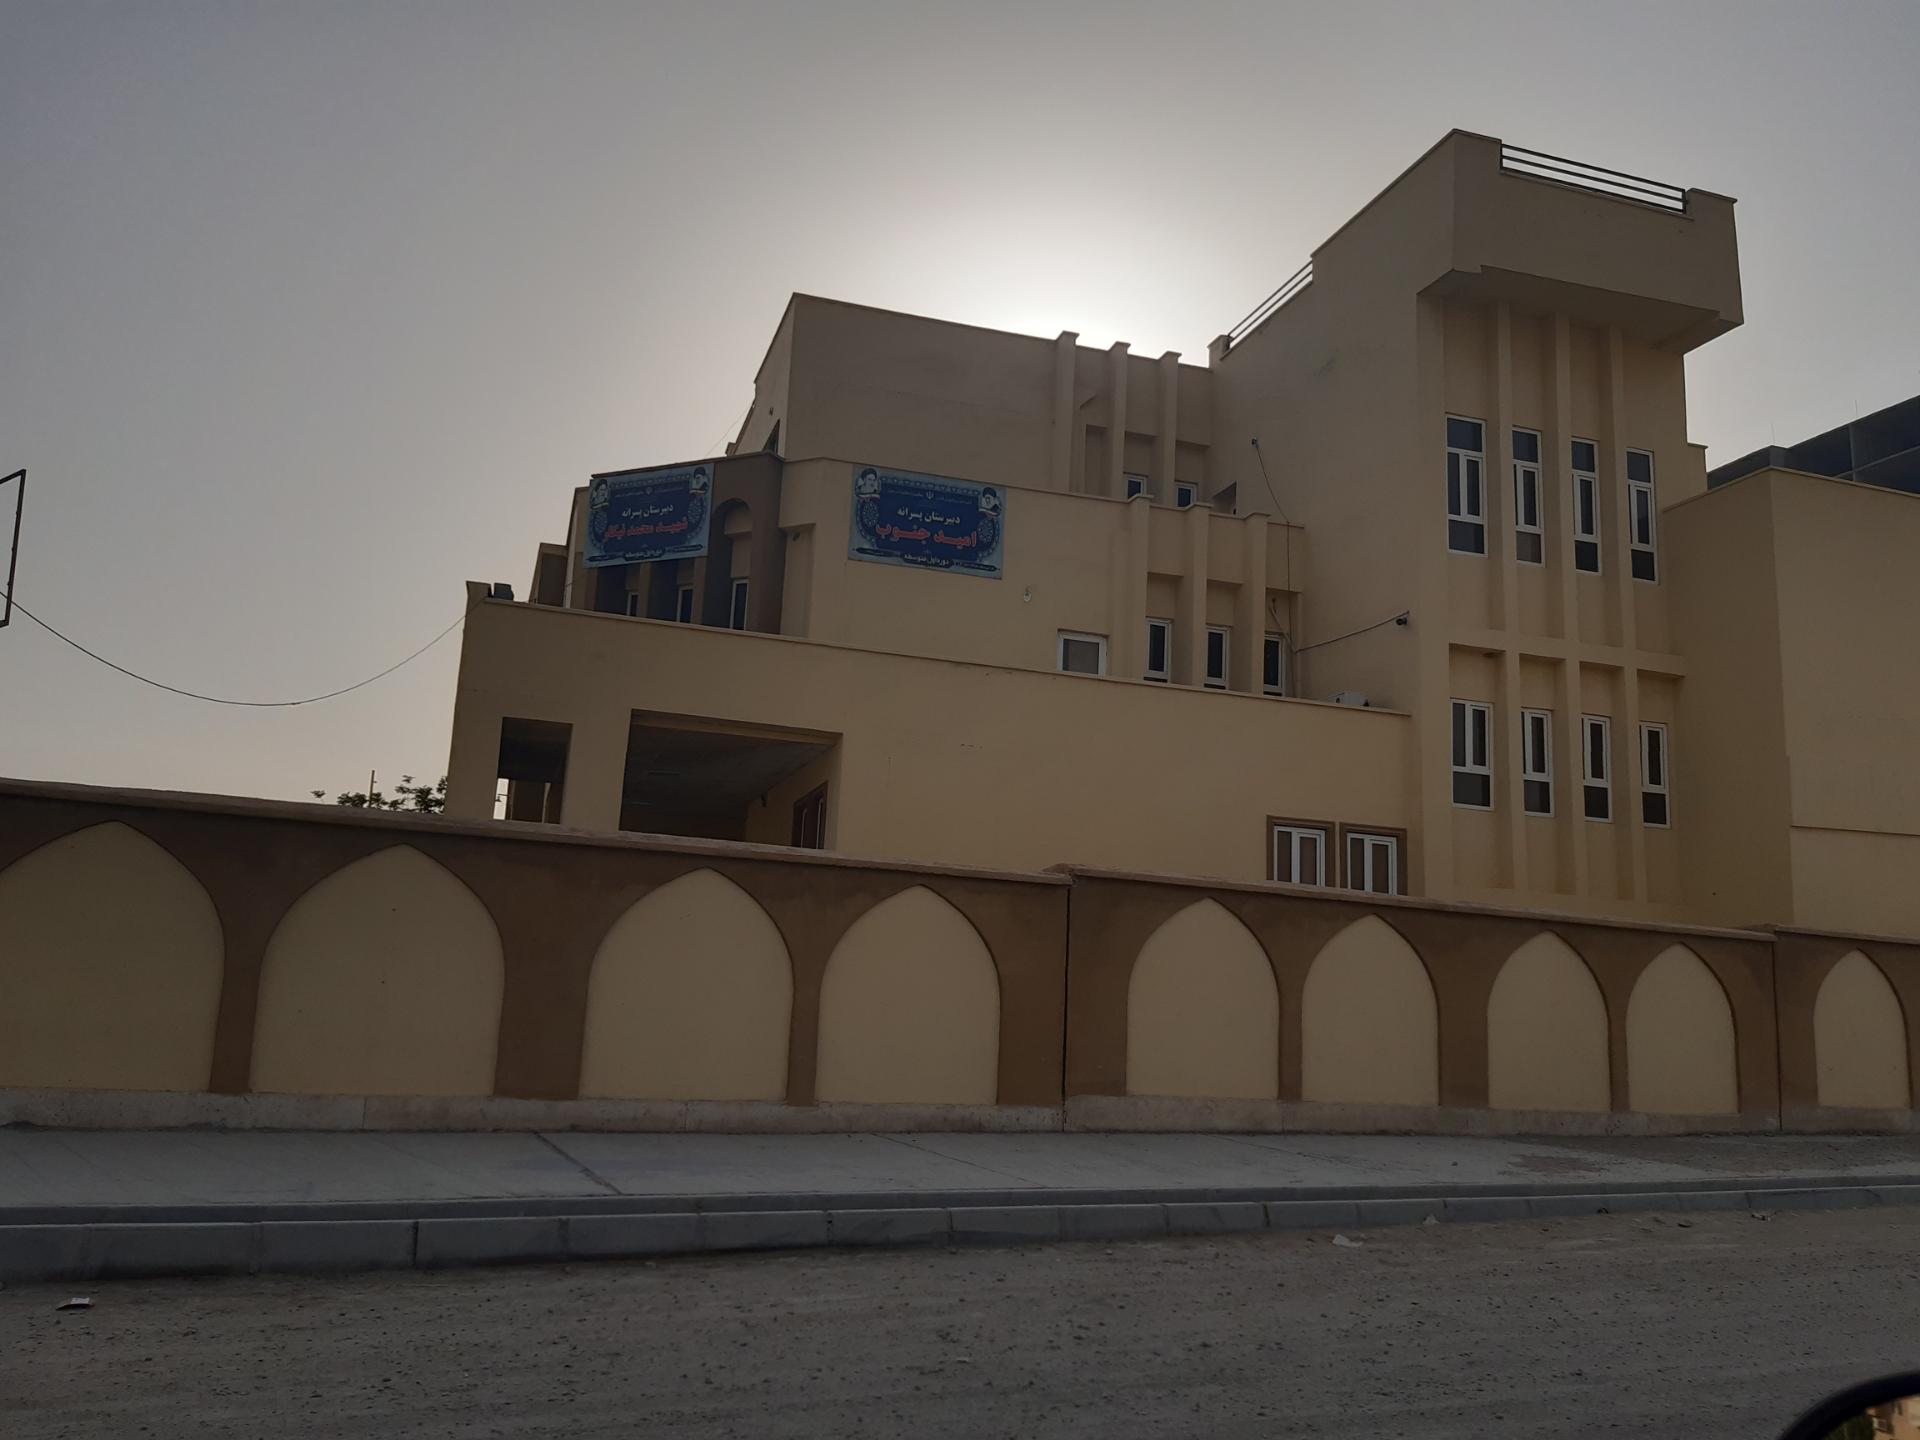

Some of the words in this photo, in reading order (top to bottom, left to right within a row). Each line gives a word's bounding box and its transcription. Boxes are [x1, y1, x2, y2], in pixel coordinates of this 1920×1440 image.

[643, 504, 673, 517] دبیرستان
[897, 506, 923, 522] پسرانه
[924, 511, 960, 525] دبیرستان
[656, 516, 688, 533] شهید
[875, 523, 930, 545] جنوب
[933, 529, 977, 549] امید
